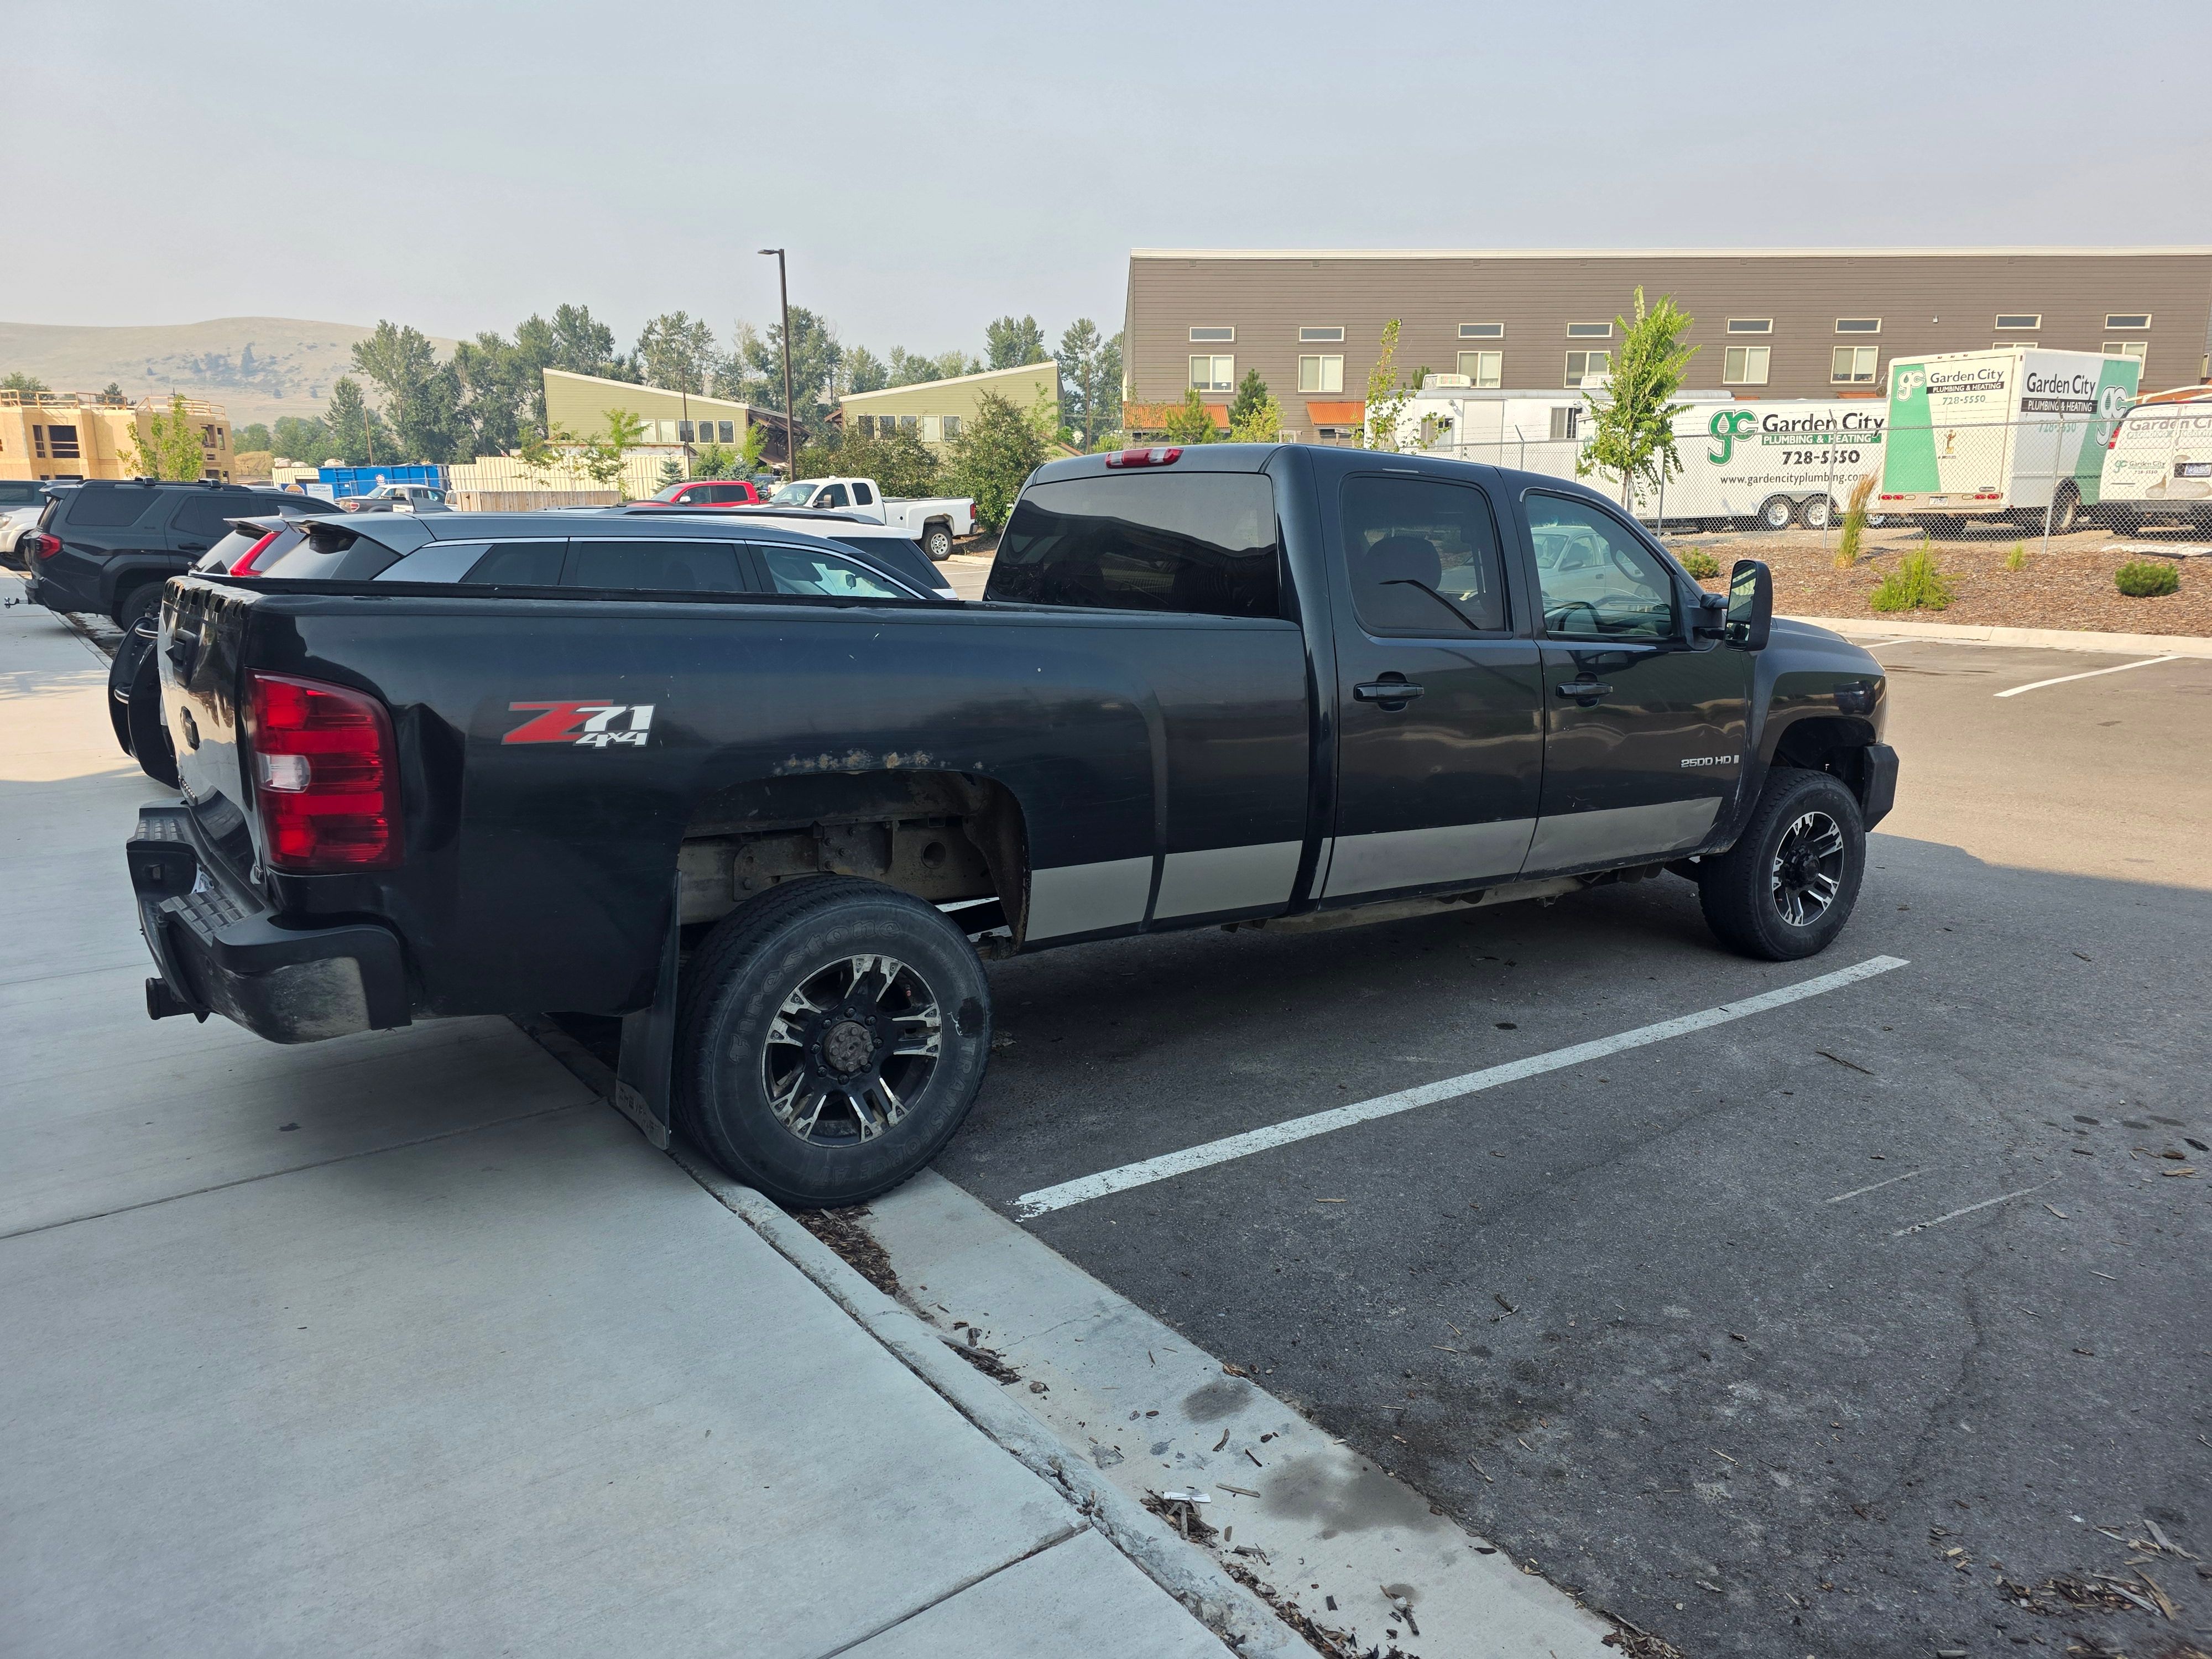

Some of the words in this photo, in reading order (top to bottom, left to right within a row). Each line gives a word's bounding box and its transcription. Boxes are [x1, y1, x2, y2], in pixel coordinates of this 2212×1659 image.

[1930, 371, 1974, 383] Garden
[1977, 368, 2005, 383] City
[1933, 385, 1964, 393] PLUMBING
[1972, 382, 2001, 390] HEATING
[2027, 372, 2070, 394] Garden
[2073, 375, 2096, 400] City
[1942, 395, 1986, 405] 728-5550
[2028, 400, 2059, 411] PLUMBING
[2060, 401, 2065, 411] &
[2066, 401, 2093, 412] HEATING
[1762, 413, 1838, 432] Garden
[1842, 412, 1885, 438] City
[2129, 418, 2190, 431] Garden
[1764, 434, 1813, 445] PLUMBING
[1817, 435, 1824, 444] &
[1720, 472, 1868, 487] www.gardencityplumbng.com
[501, 699, 656, 745] Z71
[1681, 757, 1713, 768] 2500
[1715, 755, 1732, 765] HD
[727, 921, 901, 1063] Firestone
[860, 1043, 975, 1182] TRANSFORCE
[812, 1167, 852, 1187] AT
